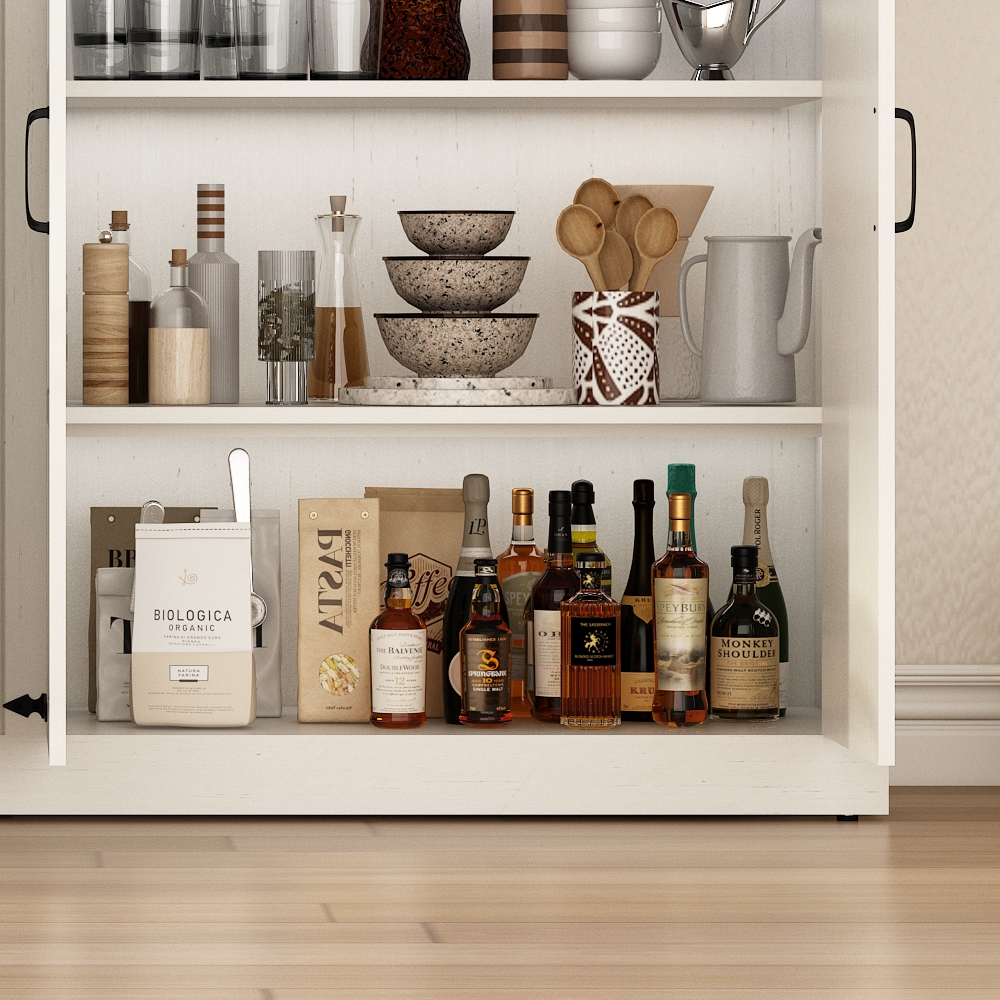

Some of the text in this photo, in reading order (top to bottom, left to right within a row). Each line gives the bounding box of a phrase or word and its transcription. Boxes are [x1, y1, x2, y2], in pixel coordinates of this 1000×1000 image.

[657, 604, 705, 612] SPEYBURN
[154, 609, 232, 622] BIOLOGICA
[721, 639, 773, 648] MONKEY
[476, 649, 499, 670] S
[395, 677, 405, 685] 12
